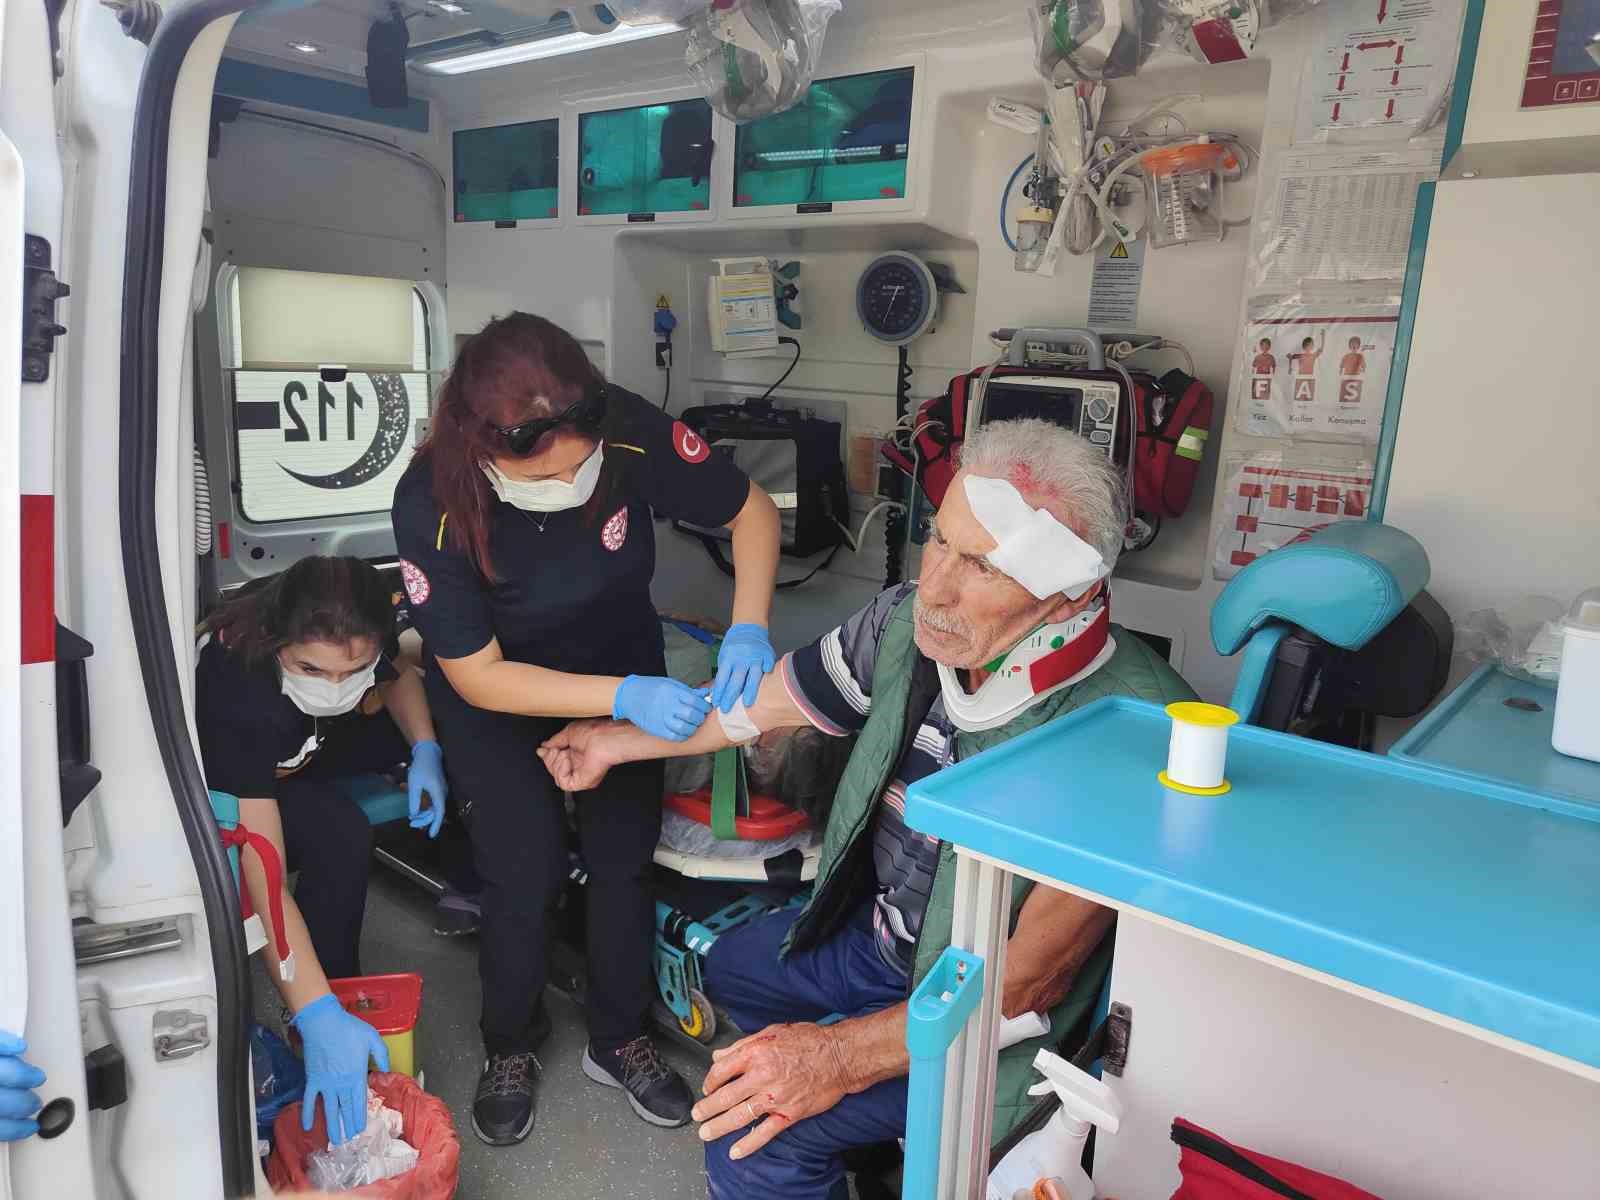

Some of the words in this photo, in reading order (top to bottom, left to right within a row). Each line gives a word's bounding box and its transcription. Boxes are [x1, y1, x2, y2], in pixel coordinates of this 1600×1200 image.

[1256, 380, 1268, 398] F
[1296, 381, 1313, 399] A
[1343, 381, 1360, 400] S
